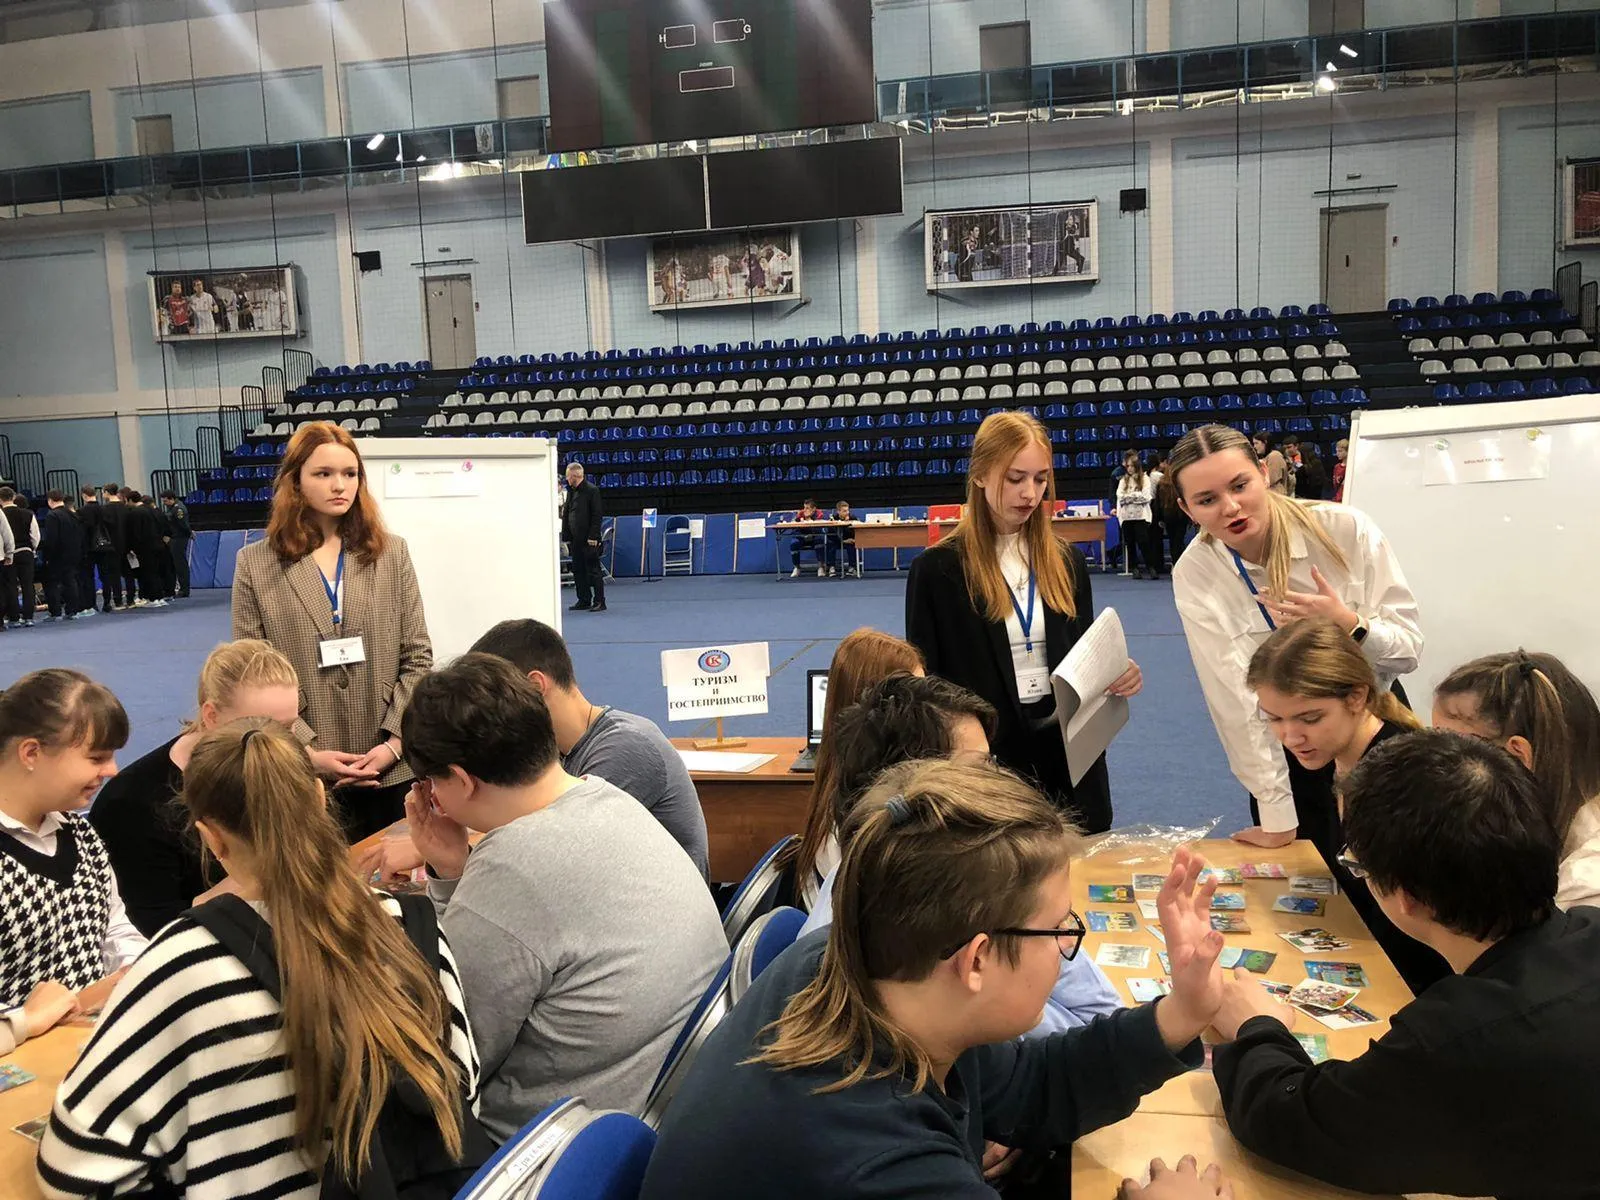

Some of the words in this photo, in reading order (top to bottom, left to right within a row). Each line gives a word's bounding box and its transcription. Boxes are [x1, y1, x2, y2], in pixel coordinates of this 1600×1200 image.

[743, 24, 752, 34] G
[659, 34, 667, 43] H
[693, 675, 738, 686] ТУРИЗМ
[669, 694, 766, 709] ГОСТЕПРИИМСТВО
